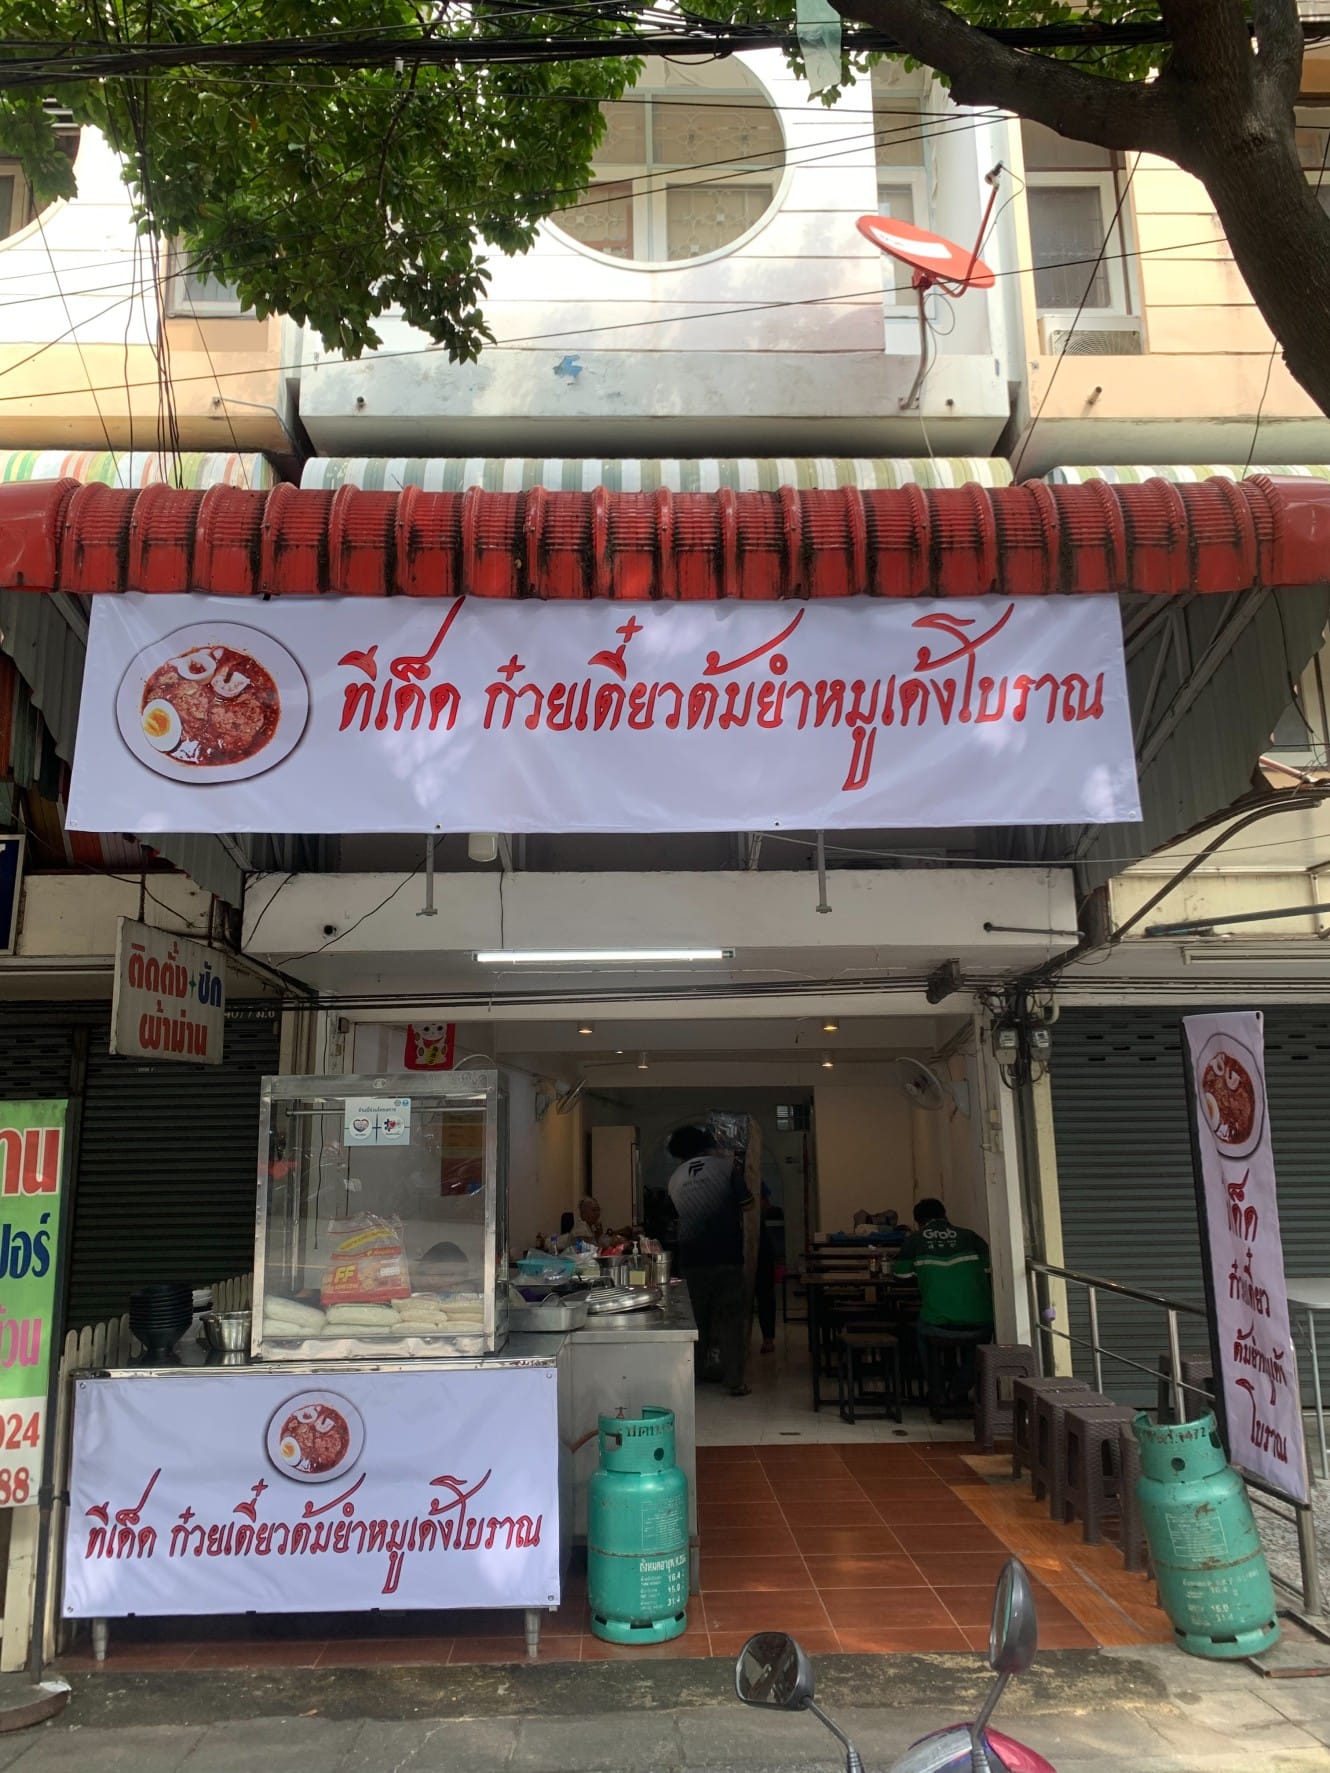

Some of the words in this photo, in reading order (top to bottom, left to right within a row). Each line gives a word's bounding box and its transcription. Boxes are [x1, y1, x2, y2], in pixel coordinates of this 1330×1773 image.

[337, 595, 466, 732] ทีเด็ด
[128, 941, 189, 999] ติดตั้ง
[139, 1000, 207, 1056] ผ้าม่าน
[923, 1228, 958, 1239] Grab
[84, 1468, 161, 1559] ทีเด็ด
